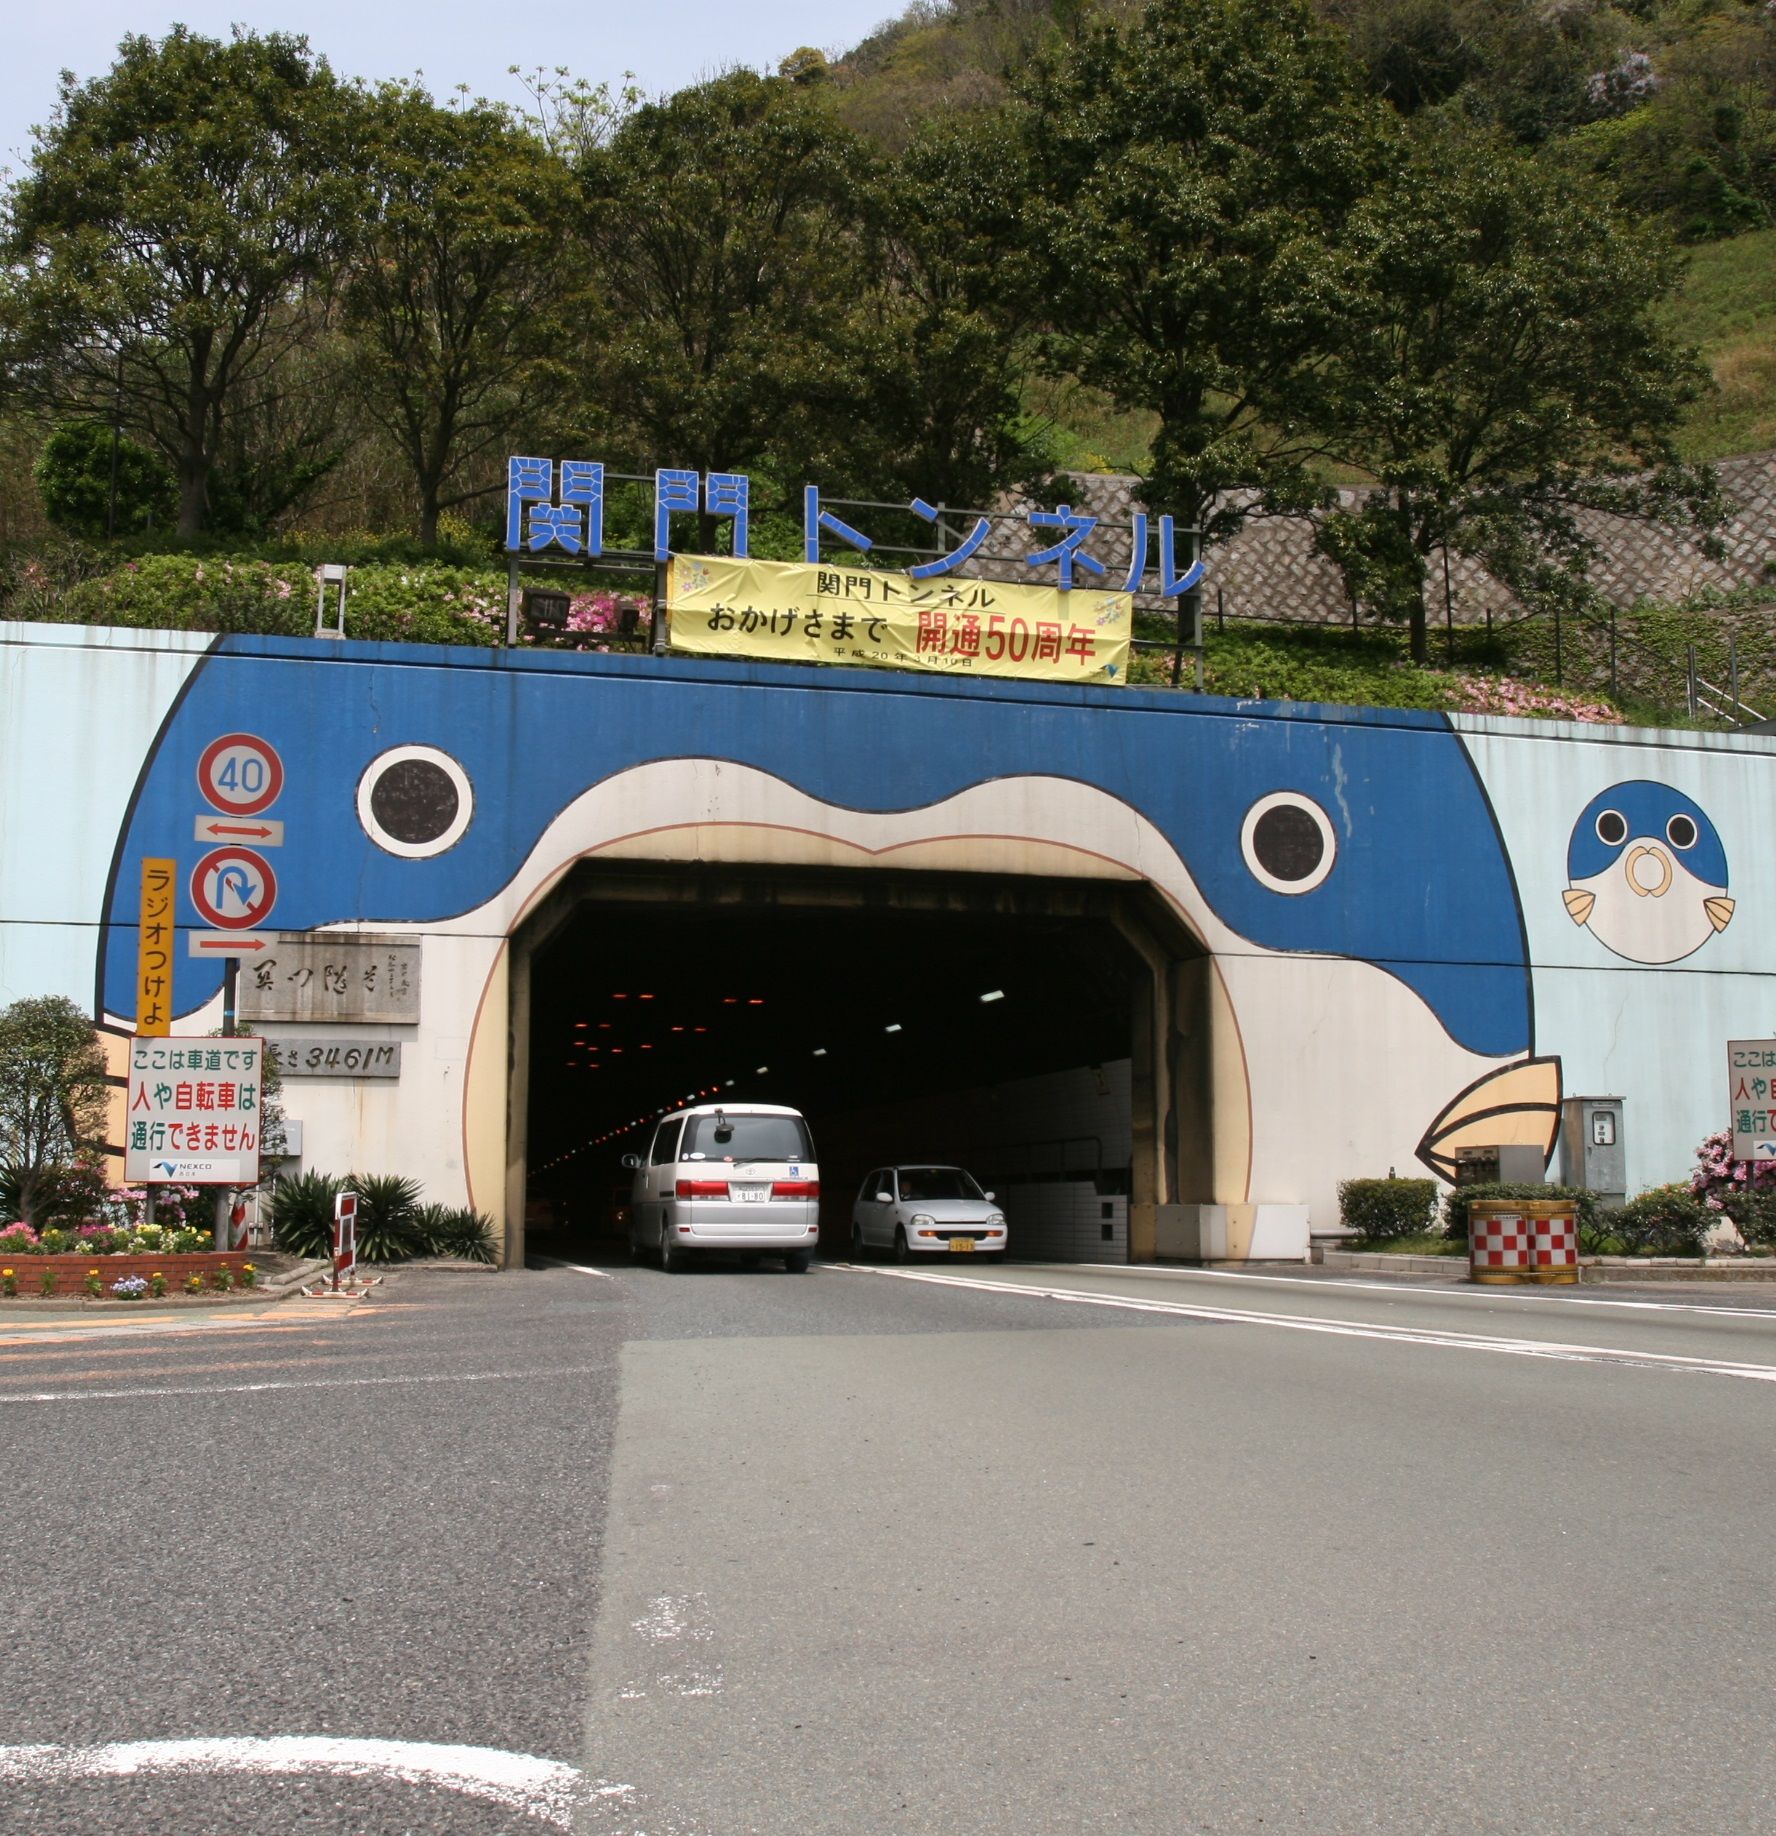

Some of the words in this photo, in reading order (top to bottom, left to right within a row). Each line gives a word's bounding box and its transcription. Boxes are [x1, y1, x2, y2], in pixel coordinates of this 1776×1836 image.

[506, 455, 1205, 598] 関門トンネル
[816, 570, 996, 609] 関門トンネル
[707, 602, 889, 644] おかげさまで
[915, 610, 1097, 667] 開通50周年
[217, 756, 264, 794] 40
[143, 868, 171, 1026] ラジオつけよ
[133, 1049, 258, 1071] ここは車道です
[131, 1080, 257, 1112] 人や自転車は
[130, 1120, 255, 1152] 通行できません
